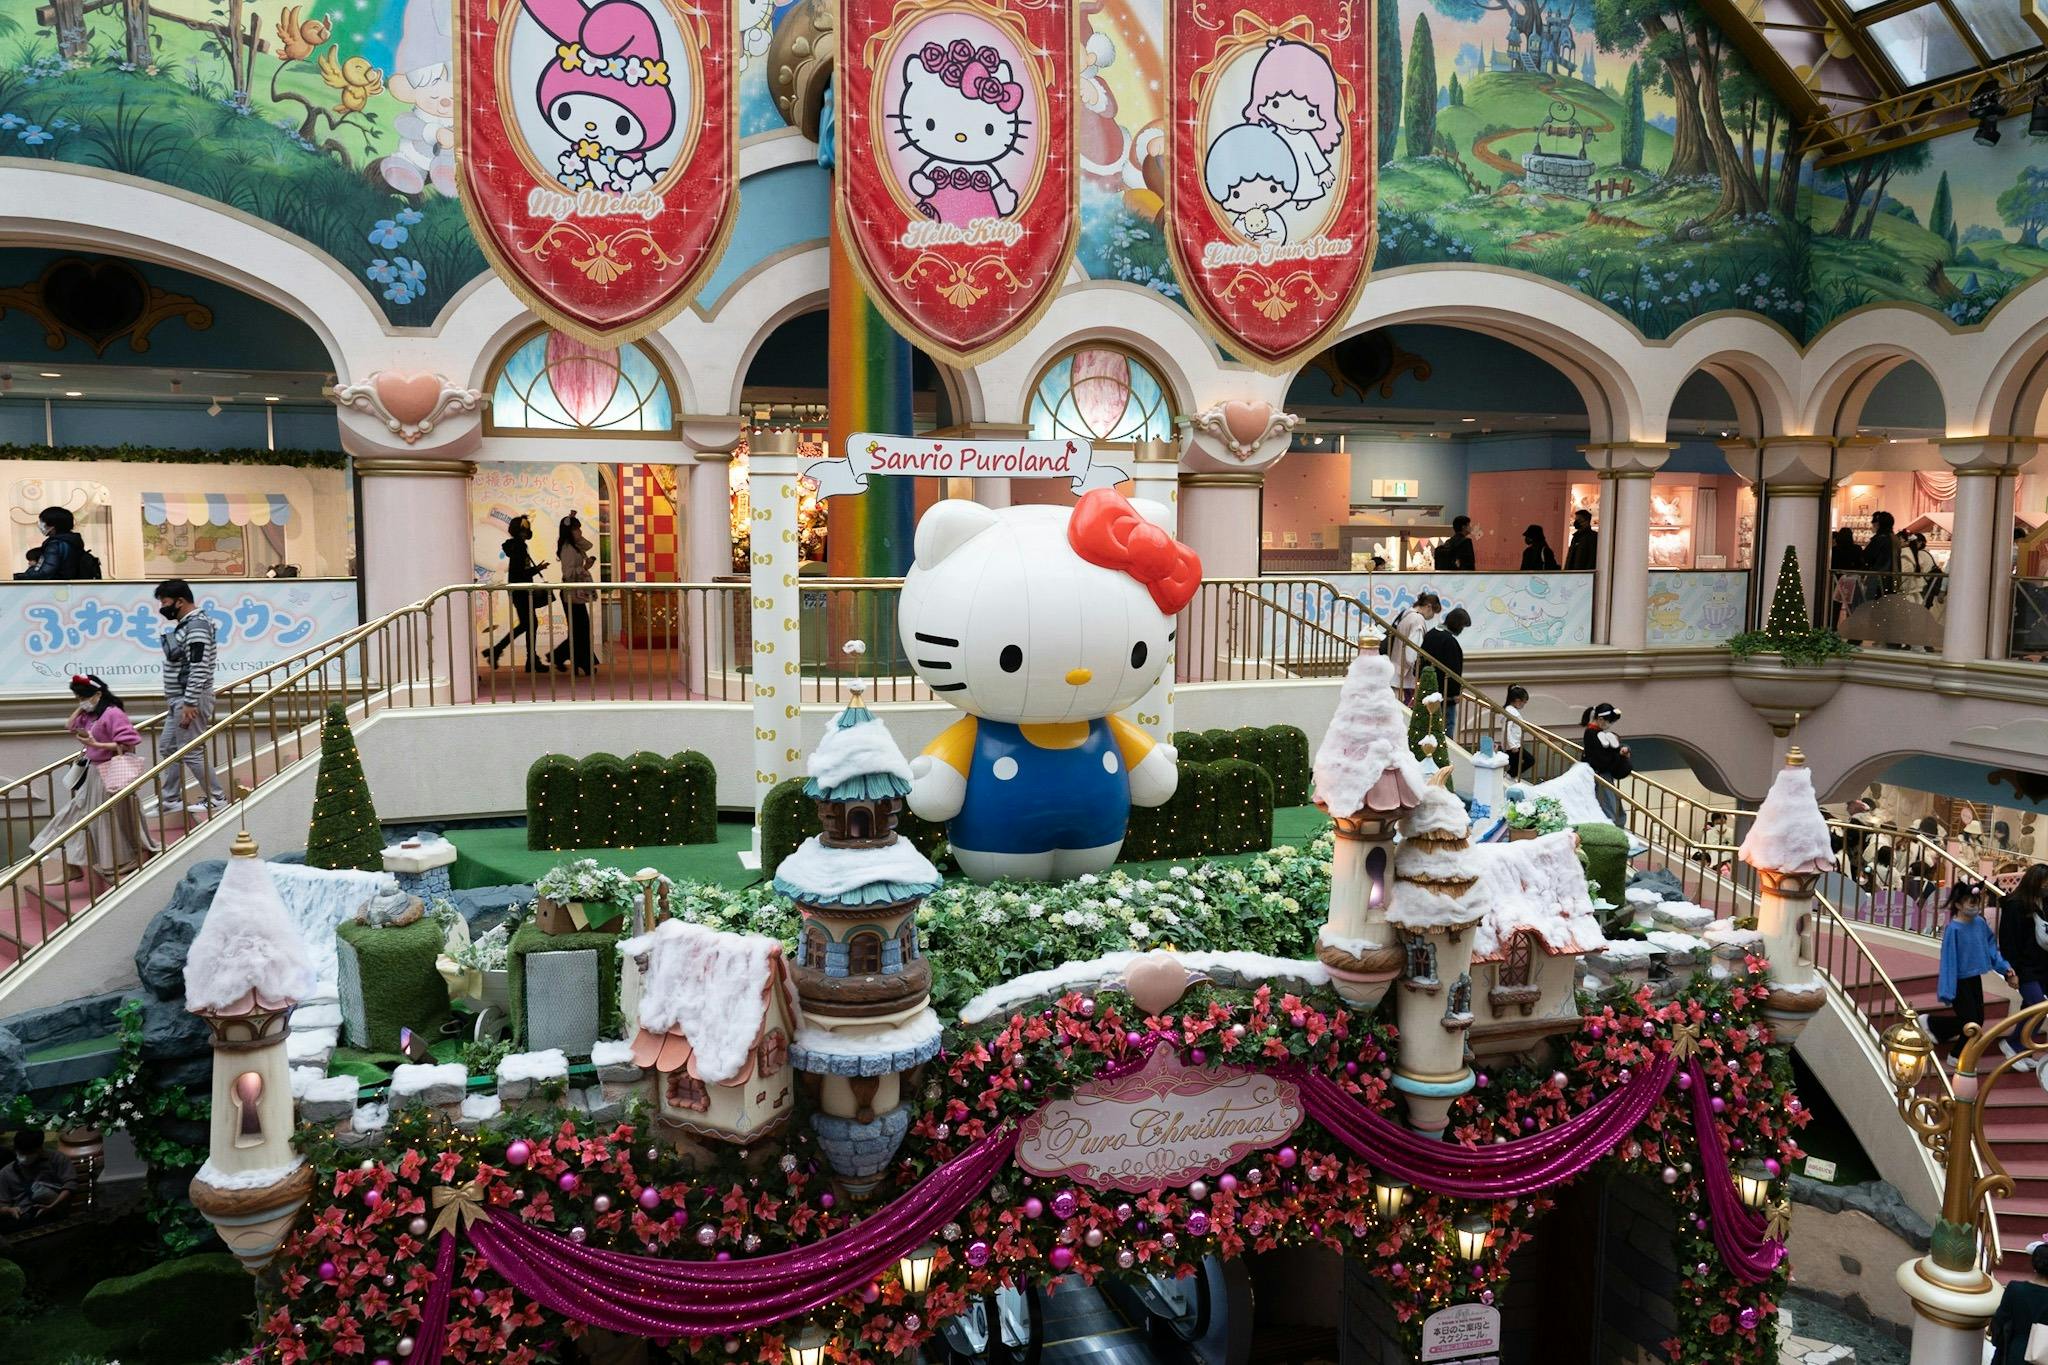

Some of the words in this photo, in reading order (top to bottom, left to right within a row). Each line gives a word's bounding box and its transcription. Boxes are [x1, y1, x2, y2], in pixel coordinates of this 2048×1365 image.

[528, 187, 576, 221] My
[577, 188, 665, 220] Melody
[901, 220, 962, 249] Hello
[962, 217, 1024, 247] Kitty
[1202, 242, 1258, 268] Little
[1258, 239, 1304, 266] Twin
[1304, 235, 1352, 260] Stars
[870, 444, 954, 470] Sanrio
[959, 446, 1071, 472] Puroland
[28, 598, 314, 651] ふわもタウン
[63, 659, 162, 677] Cinnamoro
[212, 658, 280, 677] iversar
[1045, 1111, 1129, 1160] Puro
[1130, 1096, 1275, 1147] Christmas
